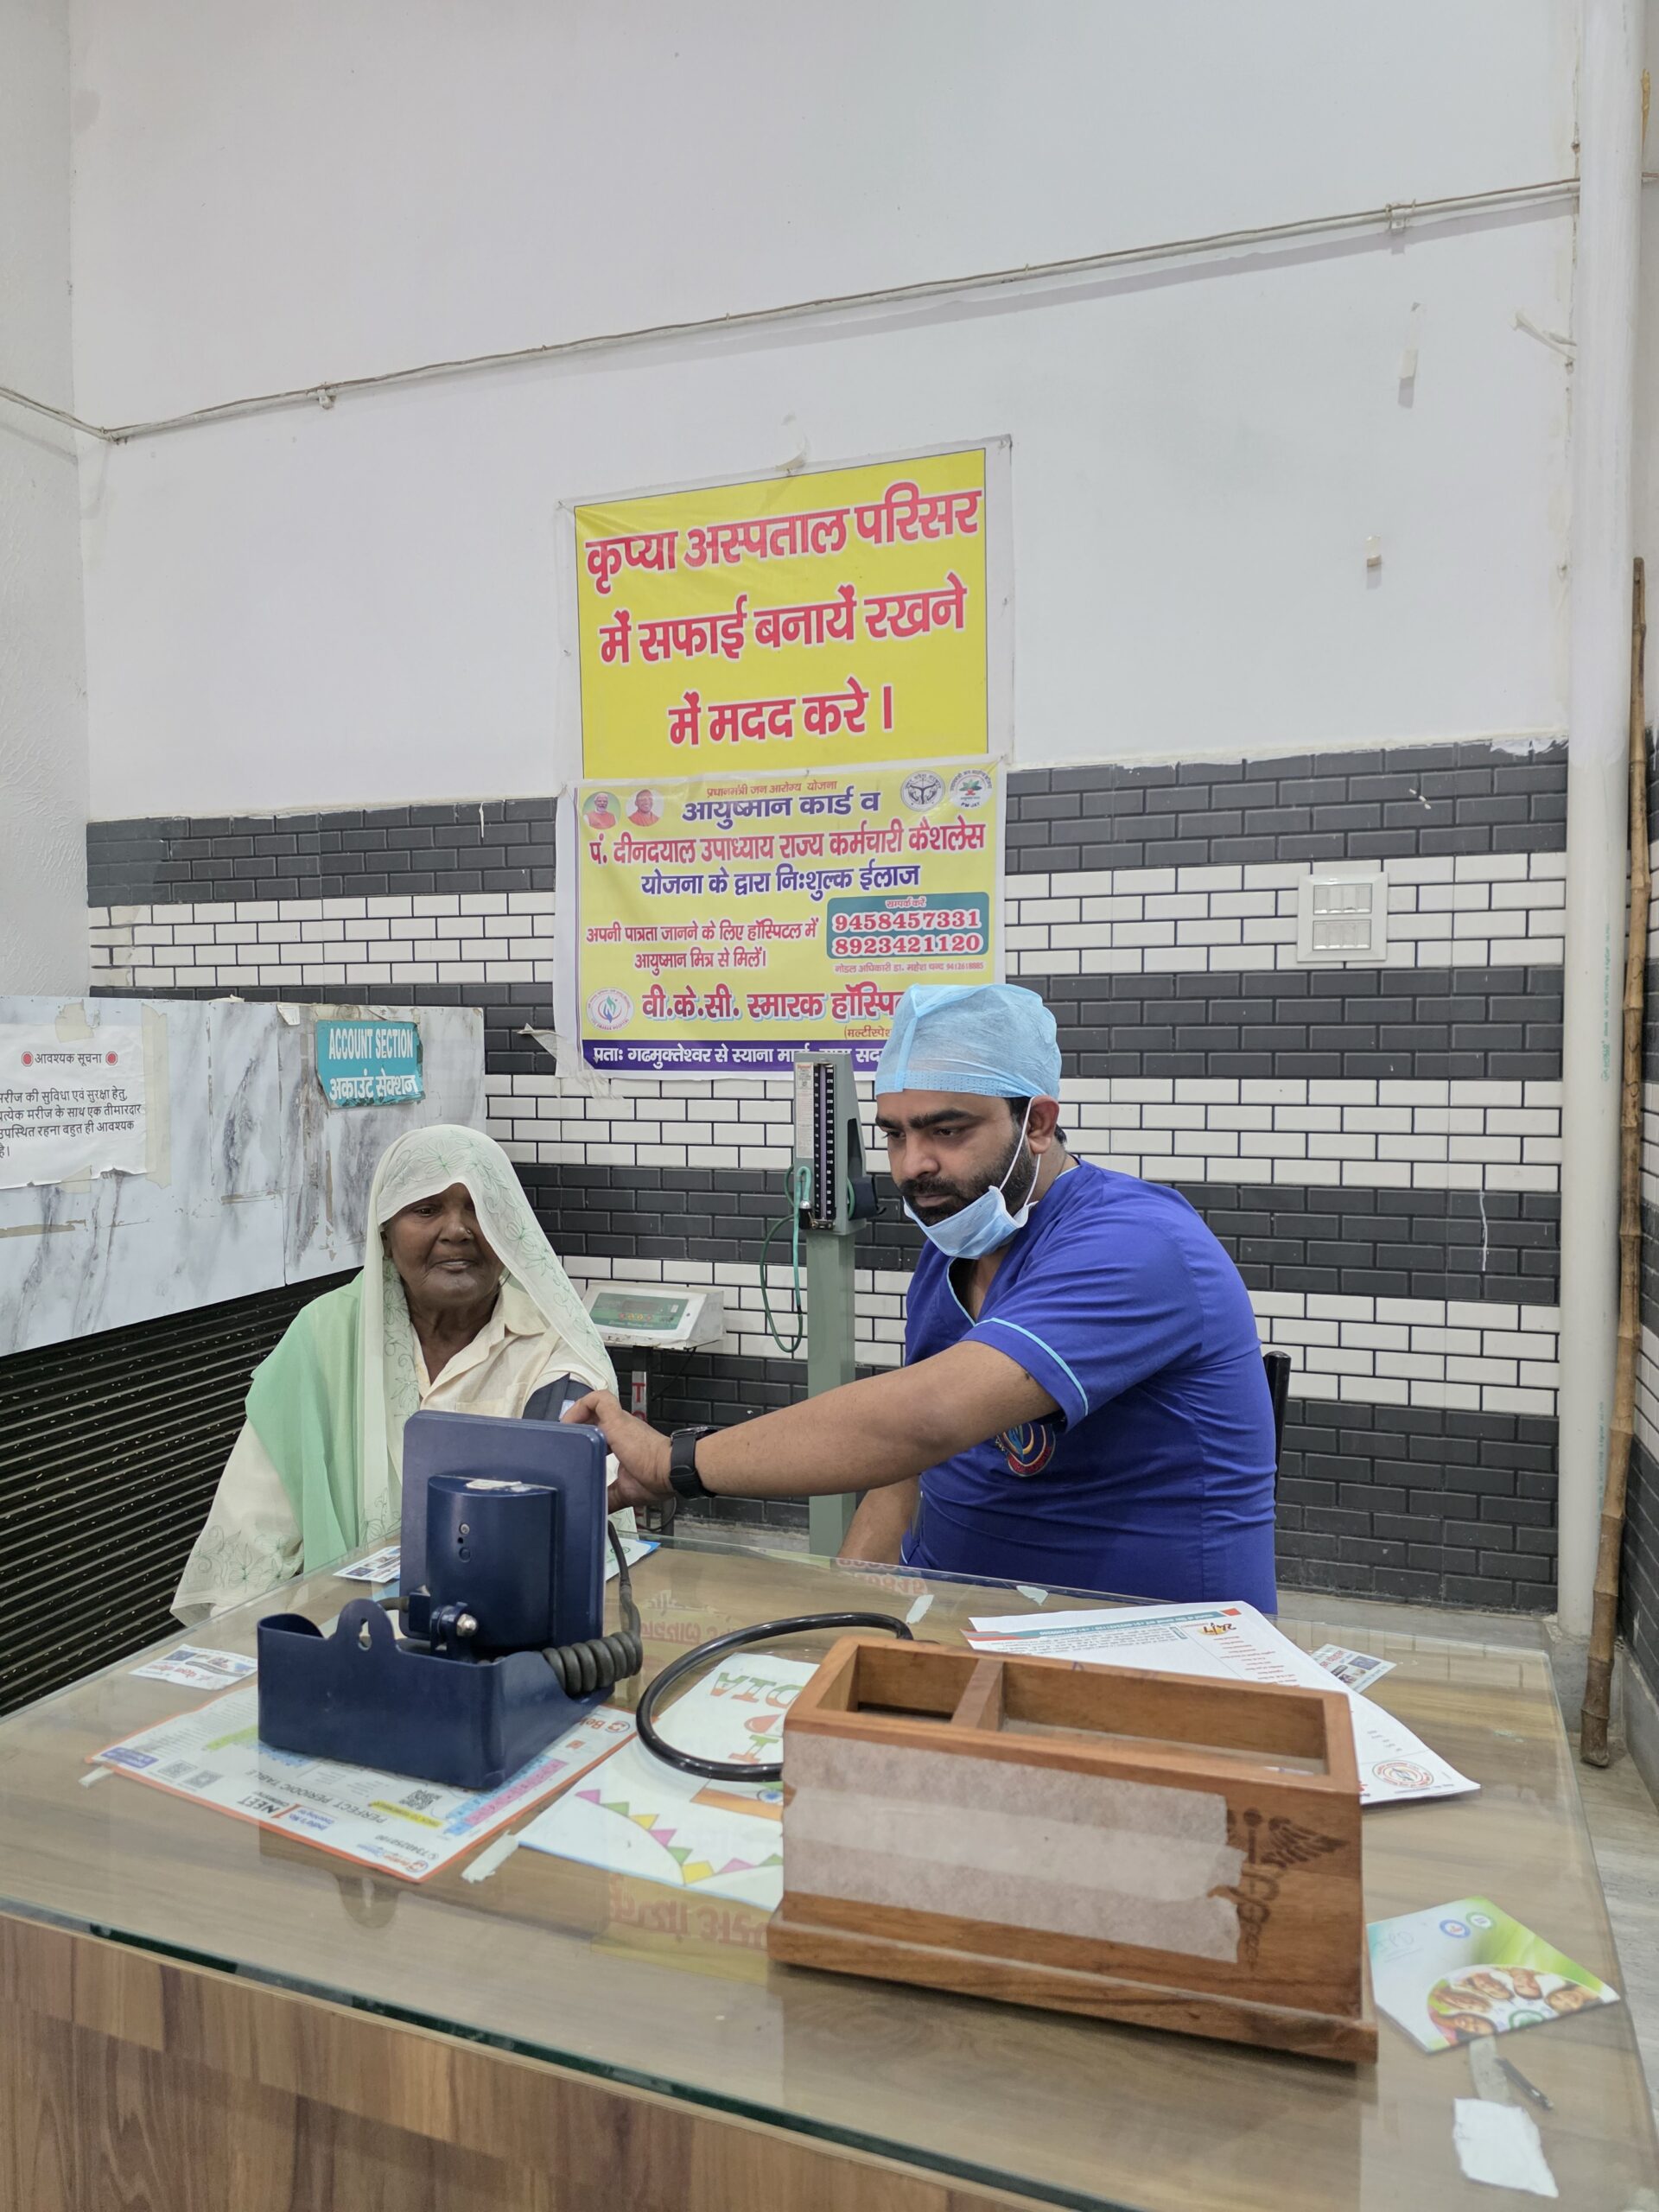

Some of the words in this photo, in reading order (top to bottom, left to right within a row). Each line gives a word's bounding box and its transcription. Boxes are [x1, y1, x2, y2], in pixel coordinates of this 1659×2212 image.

[585, 531, 678, 594] कृप्या
[684, 509, 849, 567] अस्पताल
[855, 482, 982, 543] परिसर
[600, 610, 631, 663] में
[639, 594, 747, 658] सफाई
[865, 573, 967, 639] रखने
[669, 691, 700, 745] में
[709, 699, 796, 741] मदद
[803, 677, 868, 734] करे
[750, 785, 767, 795] जन
[769, 782, 802, 794] आरोग्य
[807, 779, 837, 791] योजना
[683, 798, 793, 830] आयुष्मान
[799, 785, 854, 815] कार्ड
[861, 791, 880, 811] व
[613, 832, 696, 864] दीनदयाल
[700, 836, 774, 862] उपाध्याय
[779, 833, 823, 858] राज्य
[829, 818, 904, 855] कर्मचारी
[909, 815, 986, 851] कैशलेस
[641, 868, 703, 894] योजना
[709, 866, 729, 893] के
[734, 873, 771, 895] द्वारा
[776, 863, 854, 900] निःशुल्क
[860, 858, 920, 890] ईलाज
[587, 922, 621, 942] अपनी
[625, 926, 658, 941] पात्रता
[661, 920, 698, 940] जानने
[702, 920, 715, 940] के
[719, 919, 744, 941] लिए
[747, 918, 802, 940] हॉस्पिटल
[805, 918, 818, 937] में
[835, 912, 979, 931] 9458457331
[835, 935, 980, 954] 8923421120
[635, 953, 687, 976] आयुष्मान
[690, 947, 714, 968] मित्र
[718, 948, 729, 967] से
[642, 984, 740, 1018] वी.के.सी.
[747, 993, 824, 1018] स्मारक
[831, 982, 905, 1020] हॉस्पि
[329, 1028, 372, 1059] ACCOUNT
[376, 1028, 413, 1059] SECTION
[715, 1043, 729, 1062] से
[732, 1047, 773, 1063] स्याना
[35, 1053, 74, 1064] आवश्यक
[78, 1053, 101, 1066] सूचना
[329, 1068, 374, 1100] अकाउंट
[376, 1068, 418, 1097] सेक्शन
[26, 1089, 39, 1103] की
[41, 1088, 70, 1104] सुविधा
[73, 1088, 85, 1102] एवं
[87, 1089, 110, 1103] सुरक्षा
[27, 1106, 53, 1120] मरीज
[55, 1105, 65, 1118] के
[67, 1107, 85, 1118] साथ
[87, 1106, 102, 1119] एक
[104, 1103, 141, 1116] तीमारदार
[38, 1126, 60, 1138] रहना
[63, 1124, 83, 1139] बहुत
[85, 1121, 95, 1135] ही
[97, 1120, 134, 1132] आवश्यक
[710, 1672, 805, 1708] DIA
[245, 1769, 281, 1788] TABLE
[278, 1783, 333, 1804] PERIODIC
[237, 1796, 279, 1815] NEET
[332, 1801, 386, 1824] PERFECT
